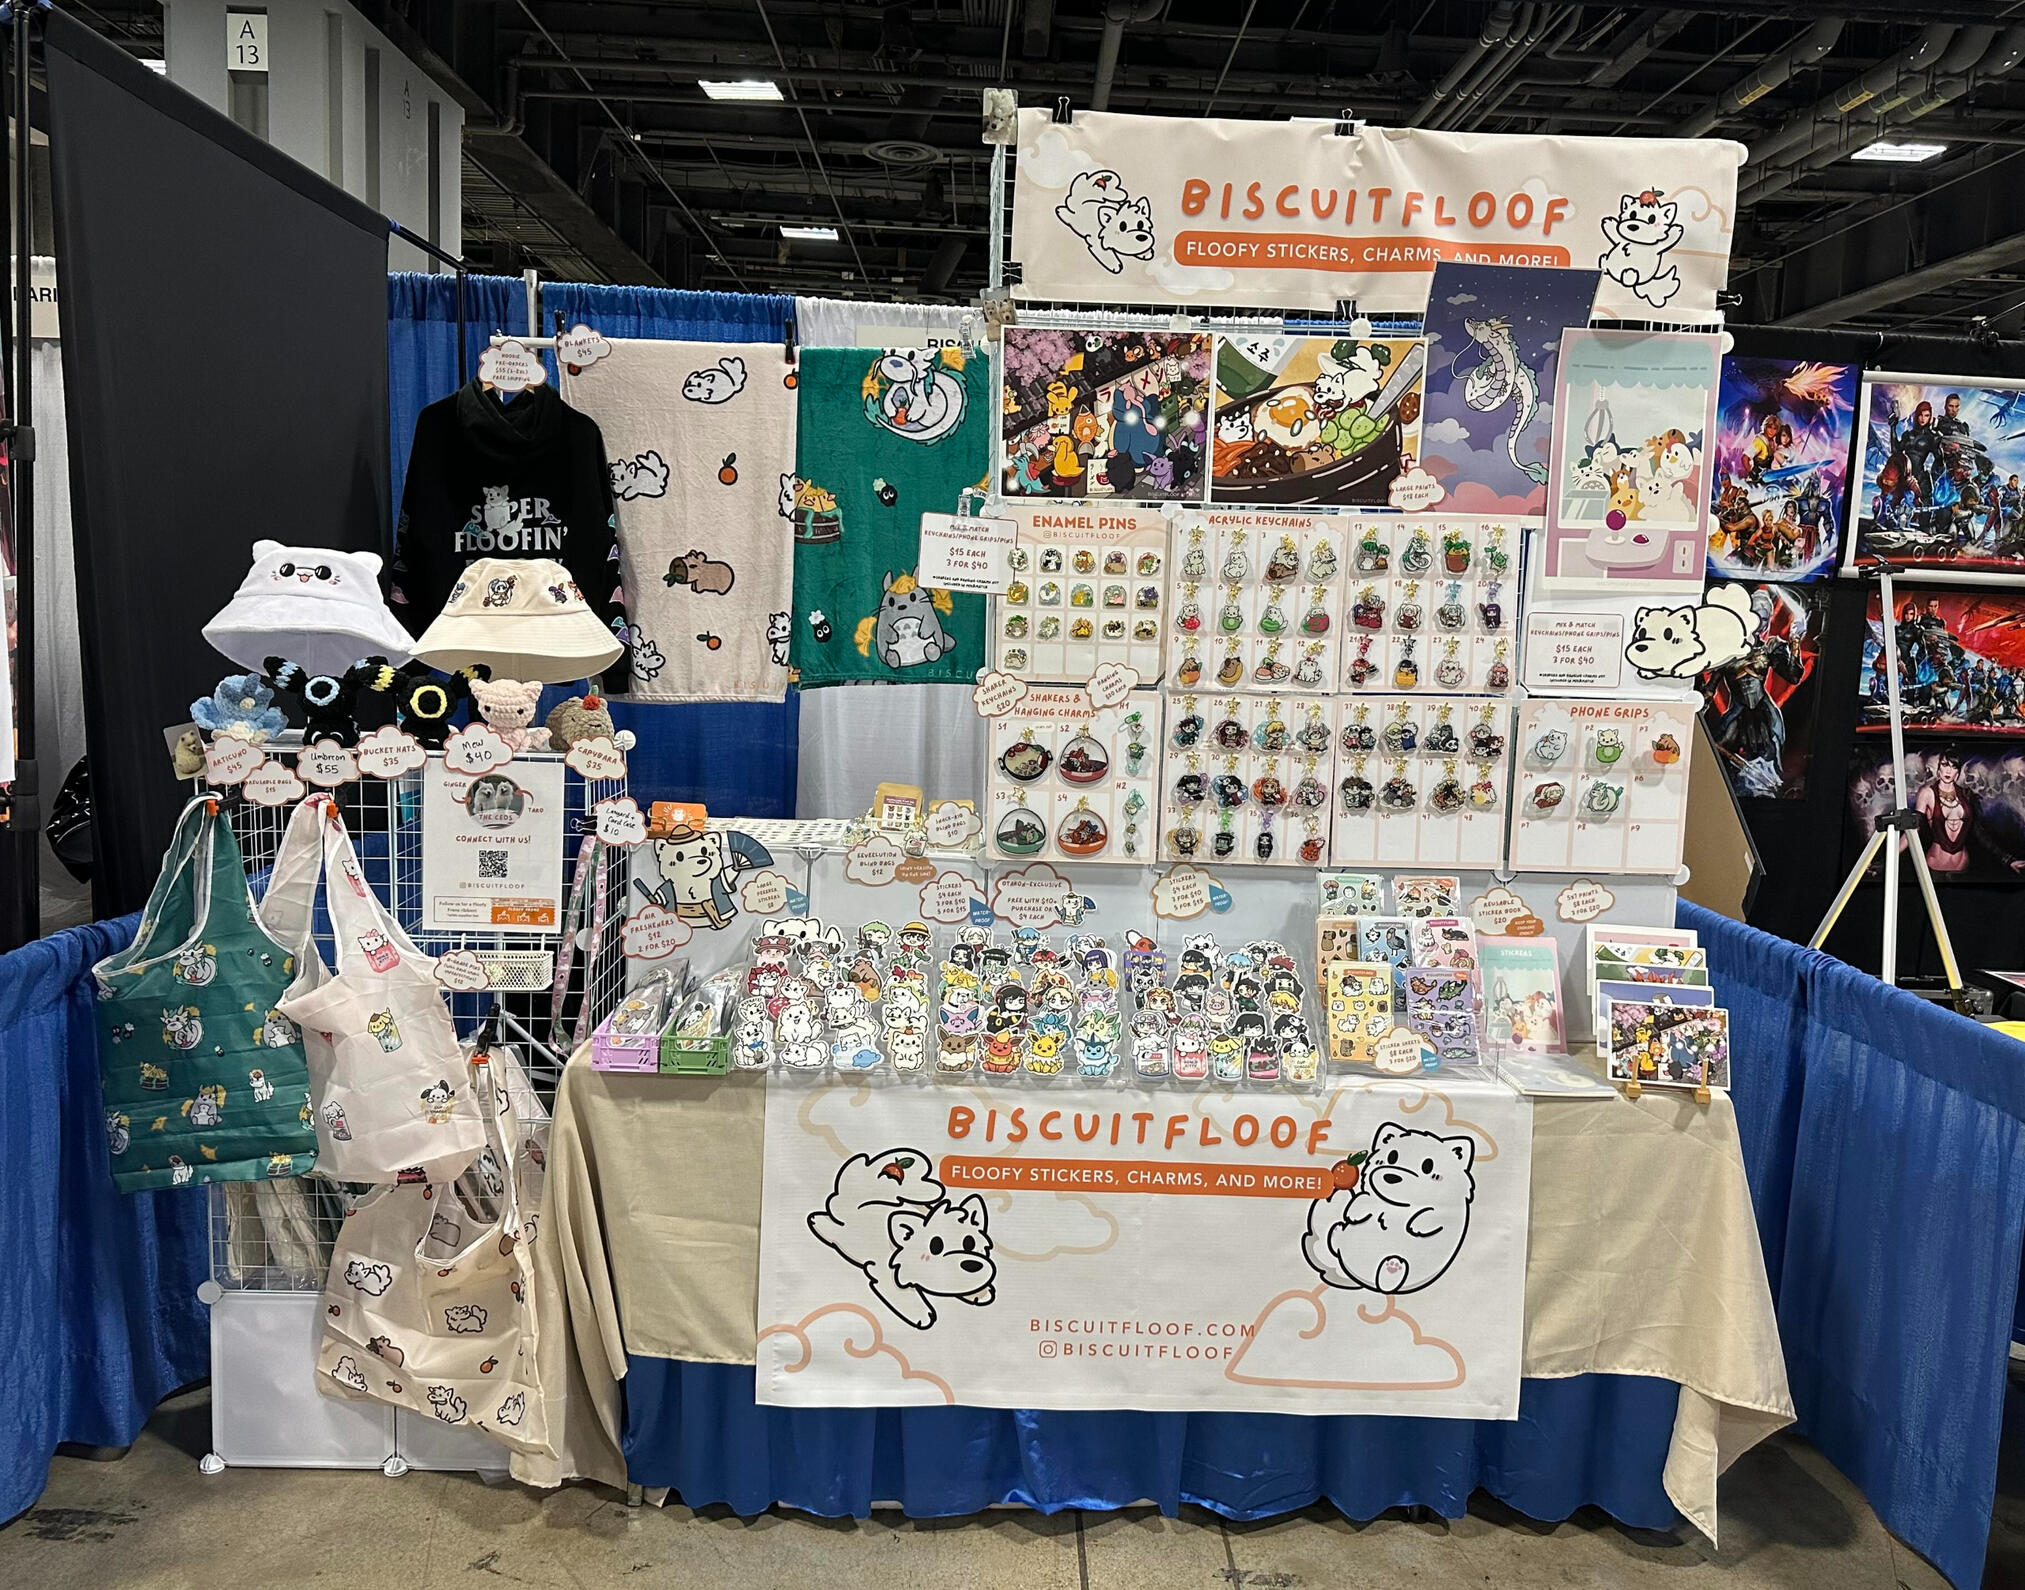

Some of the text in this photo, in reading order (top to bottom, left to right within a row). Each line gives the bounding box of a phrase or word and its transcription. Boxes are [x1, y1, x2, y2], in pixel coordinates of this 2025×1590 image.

[239, 20, 255, 40] A
[235, 45, 259, 65] 13
[1180, 177, 1570, 236] BISCUITFLOOF
[1186, 240, 1260, 259] FLOOFY
[1266, 242, 1355, 264] STICKERS,
[564, 336, 601, 348] BLANKETS
[577, 349, 593, 359] $45
[471, 497, 550, 524] SPER
[1033, 515, 1137, 531] ENAMEL PINS
[1208, 515, 1313, 528] ACRYLIC KEYCHAINS
[968, 525, 990, 533] MATCH
[454, 526, 568, 553] FLOOFIN'
[1053, 531, 1121, 540] BISCUITFLOOF
[949, 547, 986, 558] $15 EACH
[946, 559, 988, 570] 3 FOR $40
[1215, 637, 1224, 645] 10
[1555, 644, 1593, 653] $15 EACH
[1552, 656, 1558, 664] 3
[1577, 656, 1595, 665] $40
[1097, 669, 1119, 687] HANGING
[982, 679, 1008, 695] SHAKER
[1102, 678, 1123, 693] CHARMS
[981, 686, 1017, 707] KEYCHAINS
[1029, 693, 1081, 703] SHAKERS &
[996, 700, 1011, 712] $20
[1014, 707, 1096, 718] HANGING CHARMS
[1570, 706, 1649, 719] PHONE GRIPS
[1060, 724, 1070, 732] S2
[363, 745, 417, 756] BUCKET HATS
[462, 739, 484, 751] Mew
[212, 748, 248, 768] ARTICUNO
[465, 750, 493, 765] $40
[577, 746, 618, 766] CAPYBARA
[383, 757, 400, 767] $35
[586, 761, 602, 771] $35
[227, 763, 242, 775] $45
[316, 763, 340, 775] $55
[265, 786, 276, 794] $15
[494, 814, 514, 822] CEOS
[607, 817, 623, 827] Card
[603, 824, 620, 836] $10
[455, 835, 532, 845] CONNECT WITH US!
[1169, 874, 1196, 885] STICKERS
[936, 882, 962, 890] STICKERS
[1182, 883, 1197, 891] EACH
[1190, 889, 1202, 898] $10
[1578, 889, 1599, 898] PRINTS
[1180, 898, 1204, 910] FOR $15
[1483, 899, 1515, 908] REUSABLE
[1581, 898, 1596, 906] EACH
[1478, 907, 1521, 917] STICKER BOOK
[1576, 904, 1601, 915] FOR $20
[644, 912, 656, 920] AIR
[1494, 917, 1507, 925] $20
[630, 919, 674, 934] FRESHENERS
[647, 931, 661, 941] $12
[644, 938, 676, 951] FOR $20
[1500, 949, 1533, 958] STICKERS
[1379, 1039, 1421, 1050] STICKER SHEETS
[946, 1105, 1332, 1155] BISCUITFLOOF
[951, 1164, 1322, 1190] FLOOFY STICKERS, CHARMS, AND MORE!
[1029, 1318, 1255, 1338] BISCUITFLOOF.COM
[1062, 1342, 1233, 1360] BISCUITFLOOF
